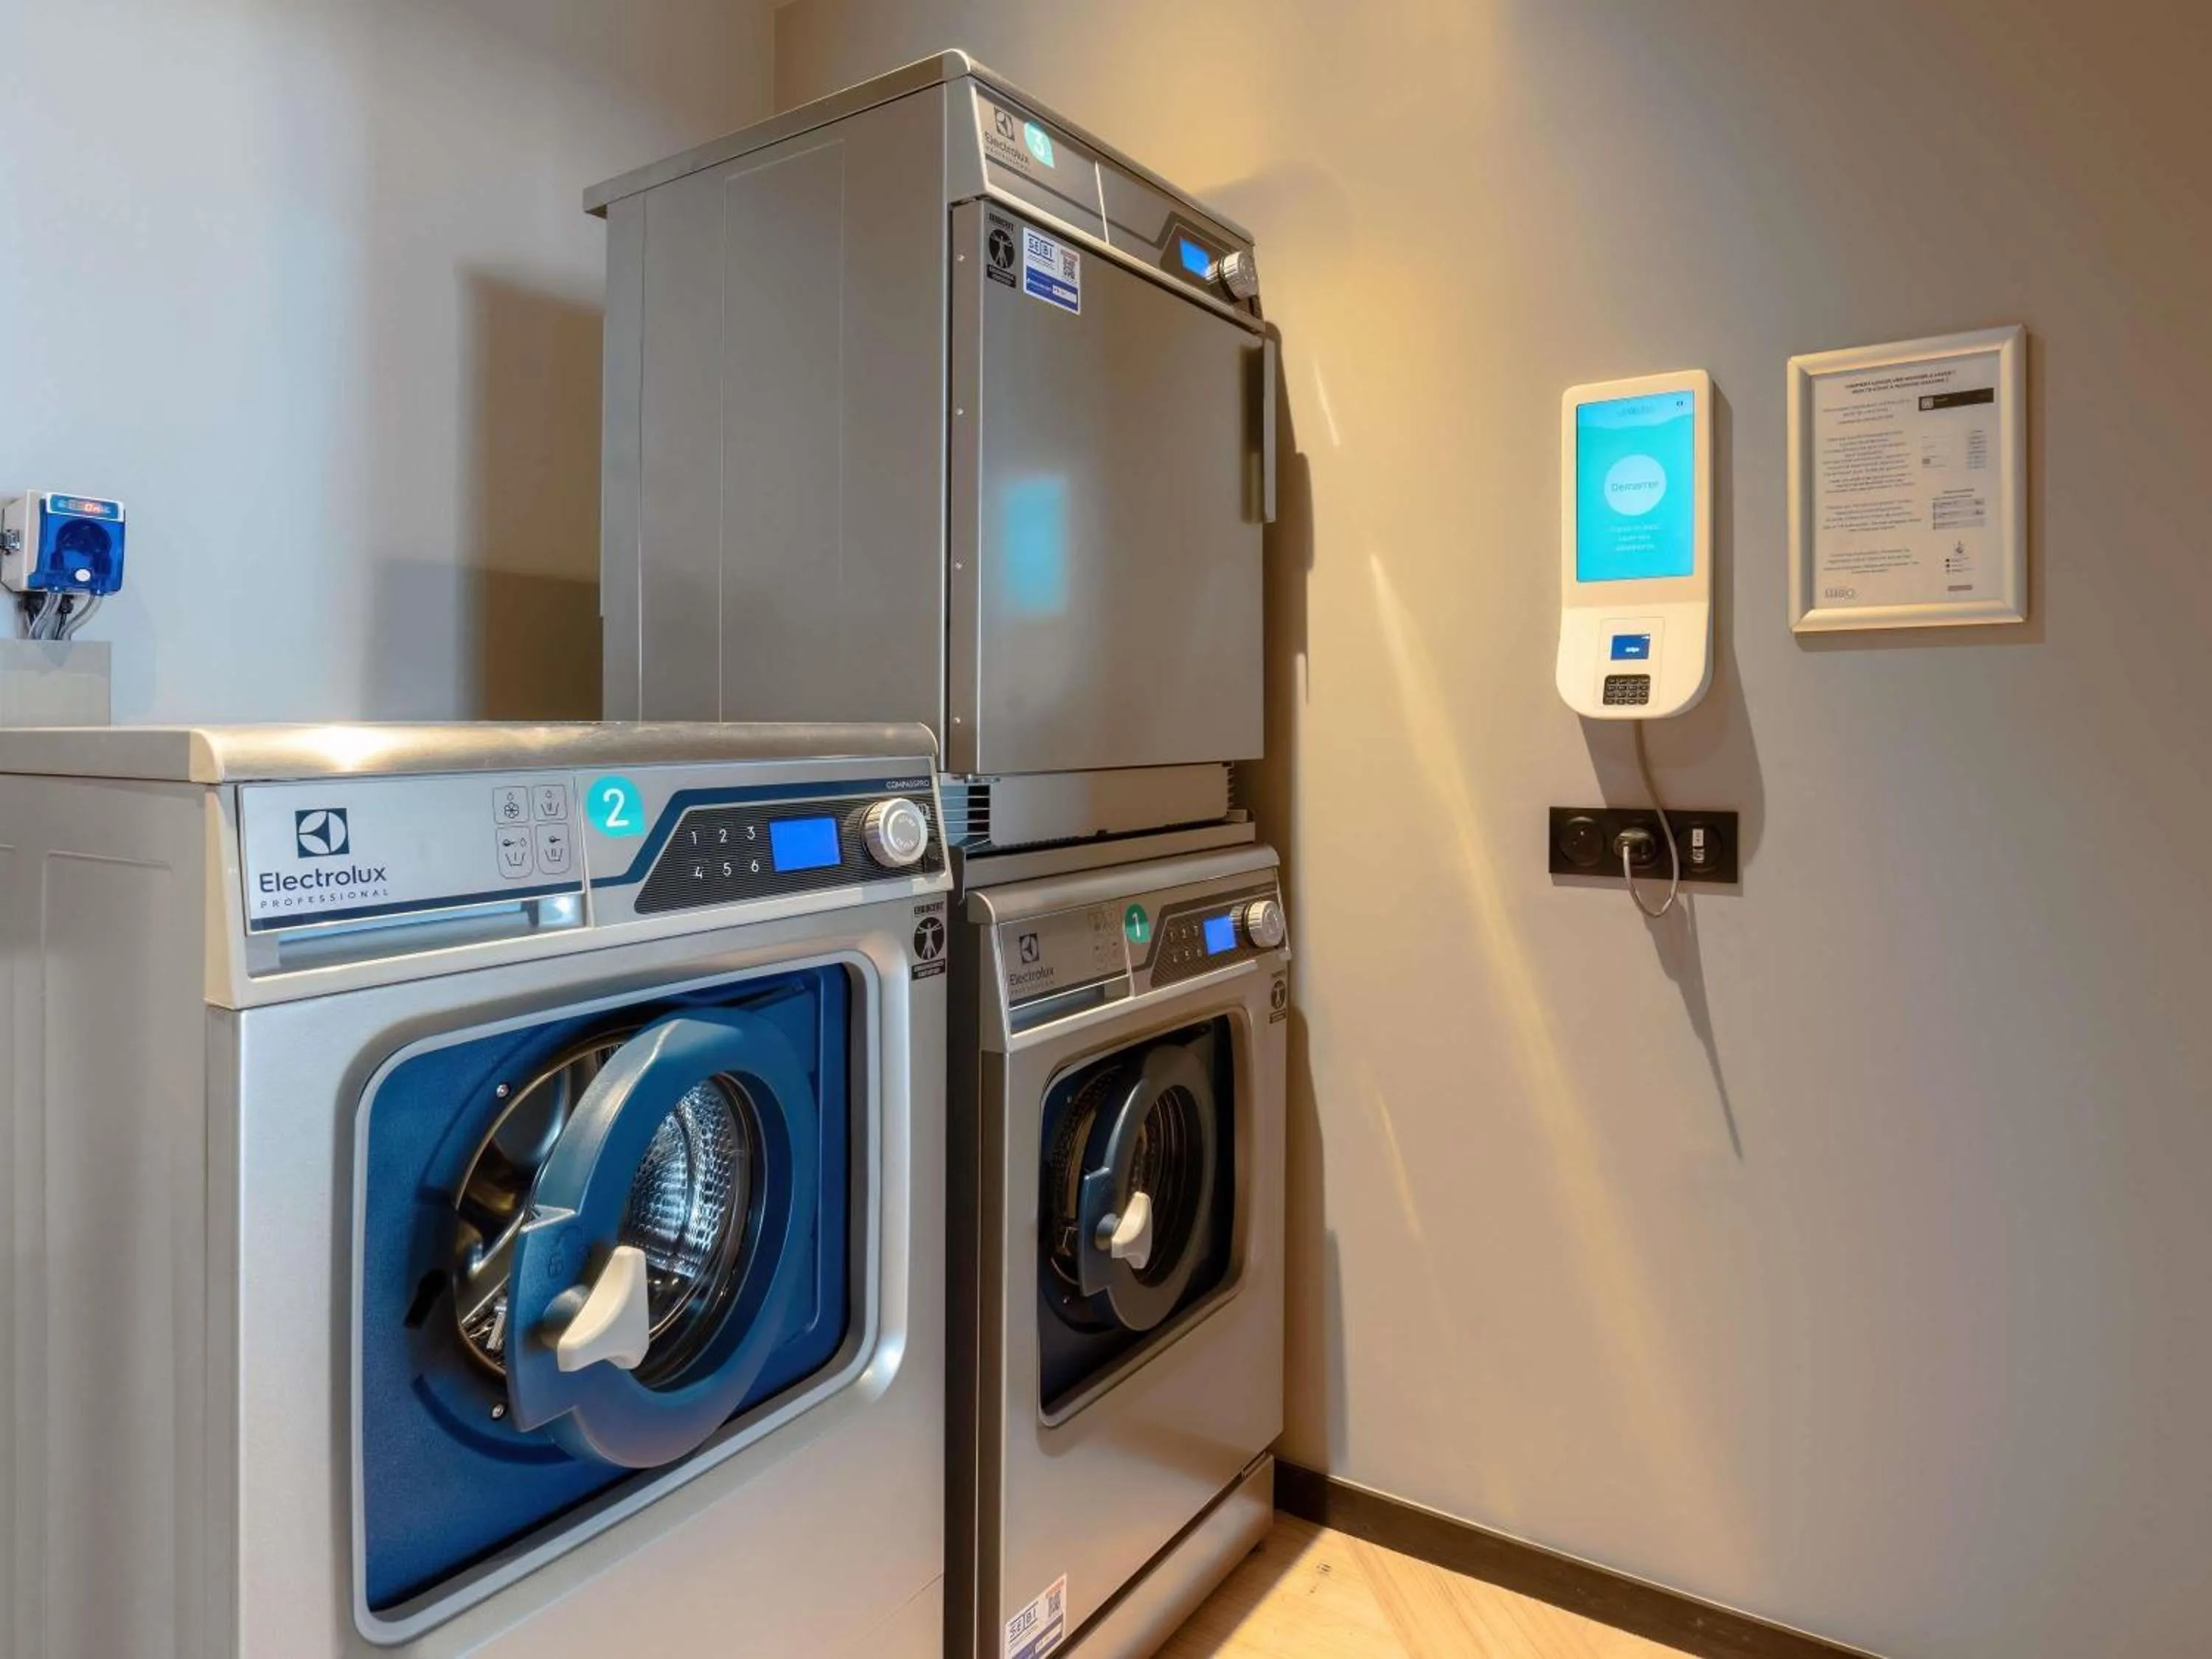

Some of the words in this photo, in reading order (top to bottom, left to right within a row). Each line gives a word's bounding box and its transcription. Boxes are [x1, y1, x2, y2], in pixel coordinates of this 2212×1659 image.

[1029, 125, 1046, 157] 3
[602, 787, 630, 828] 2
[690, 831, 698, 845] 1
[719, 828, 728, 844] 2
[747, 826, 757, 841] 3
[259, 865, 387, 893] Electrolux
[695, 865, 704, 880] 4
[723, 862, 732, 877] 5
[751, 858, 760, 873] 6
[260, 889, 389, 909] PROFESSIONAL
[1132, 913, 1141, 938] 1
